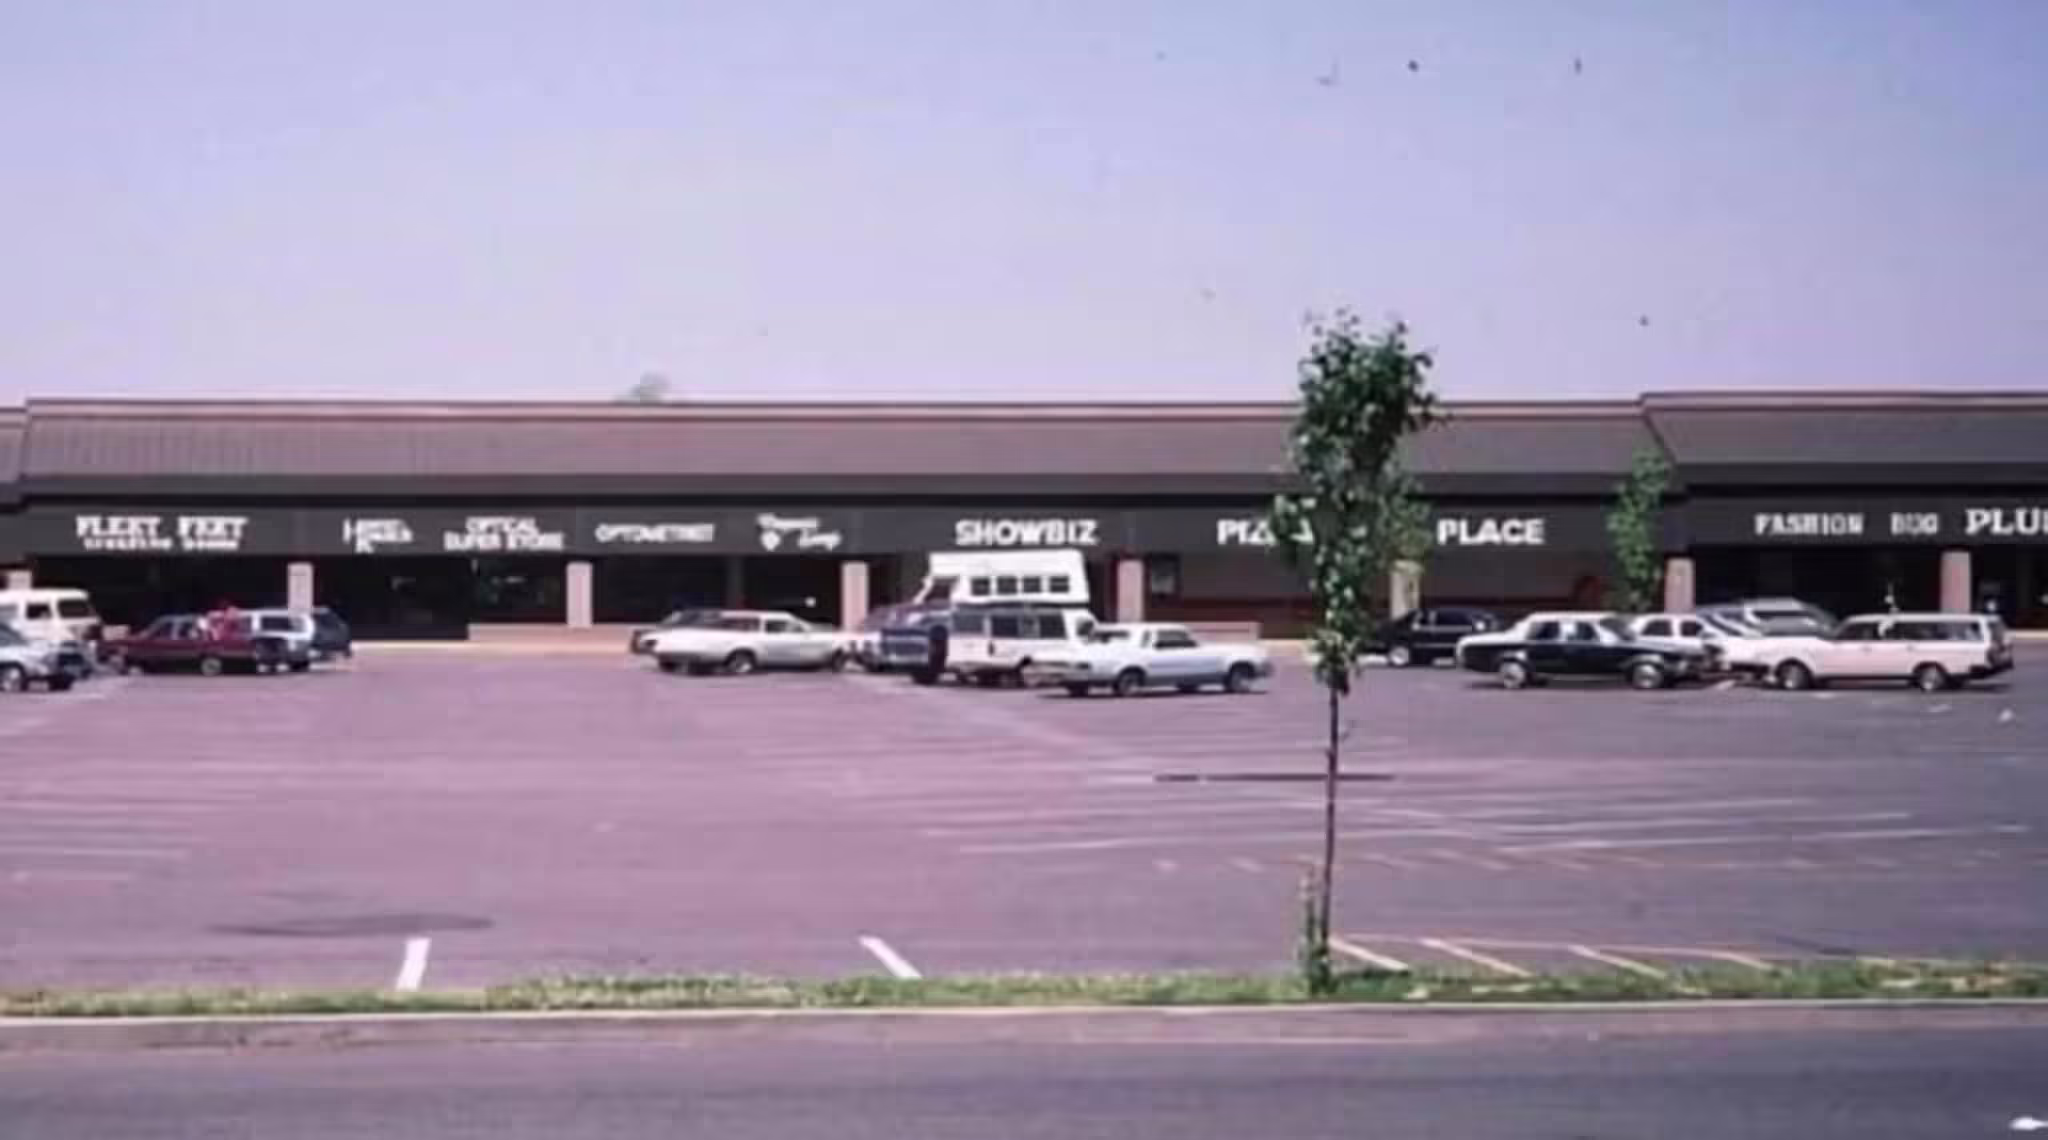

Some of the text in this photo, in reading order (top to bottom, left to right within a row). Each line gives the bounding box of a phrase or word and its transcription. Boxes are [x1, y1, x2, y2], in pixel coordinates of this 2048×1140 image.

[955, 519, 1099, 545] SHOWBIZ
[1437, 518, 1545, 545] PLACE
[1754, 513, 1865, 536] FASHION
